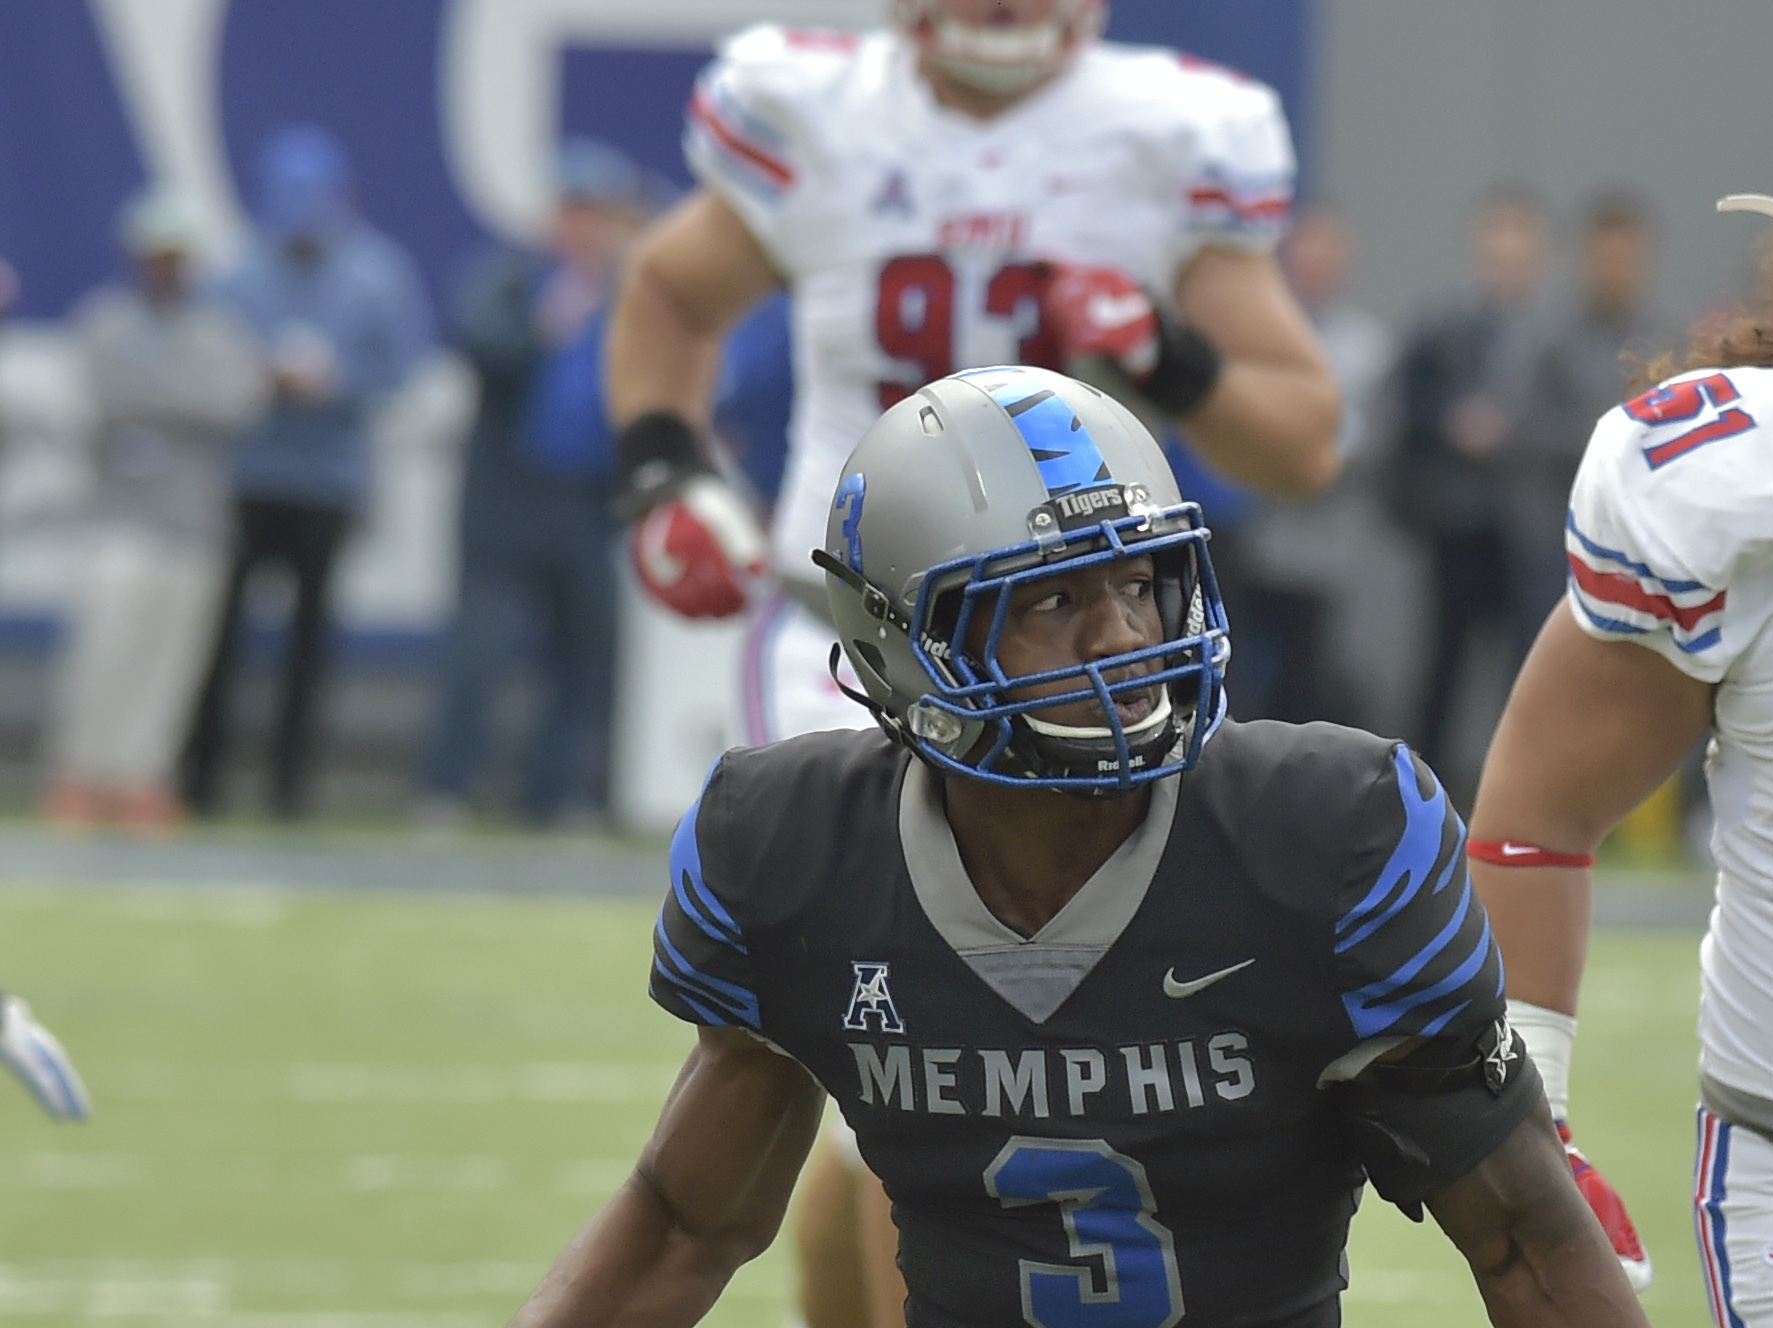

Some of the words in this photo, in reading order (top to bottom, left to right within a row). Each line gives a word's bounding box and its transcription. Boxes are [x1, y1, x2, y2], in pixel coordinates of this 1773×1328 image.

[1620, 372, 1758, 472] 51
[835, 472, 867, 588] 3
[1055, 488, 1122, 519] Tigers
[847, 1031, 1256, 1118] MEMPHIS
